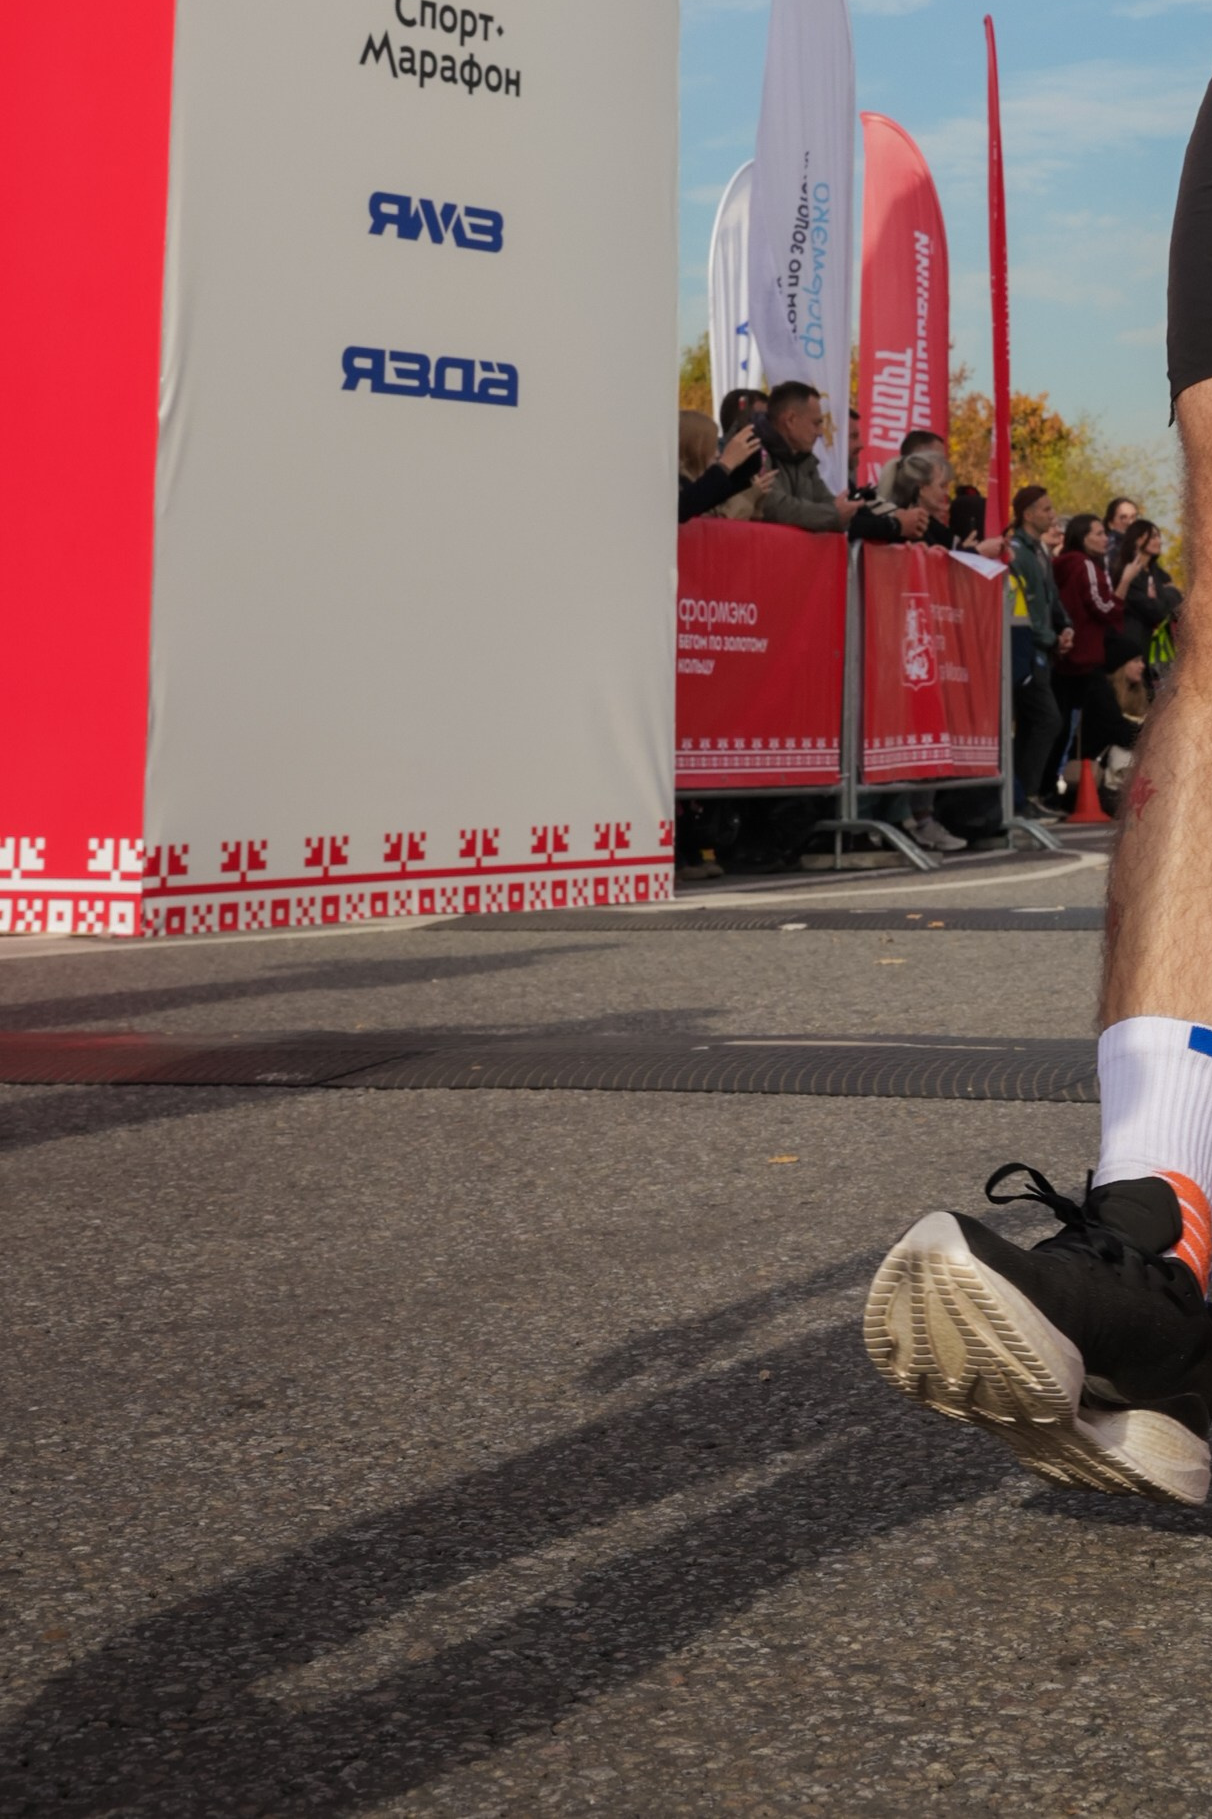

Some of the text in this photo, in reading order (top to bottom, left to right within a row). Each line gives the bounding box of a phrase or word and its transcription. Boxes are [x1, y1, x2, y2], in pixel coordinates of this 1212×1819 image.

[359, 30, 521, 98] Марафон
[368, 191, 504, 253] ЯМЗ
[679, 598, 758, 632] фармэко
[678, 633, 769, 653] БЕГОМ ПО ЗОЛОТОМУ
